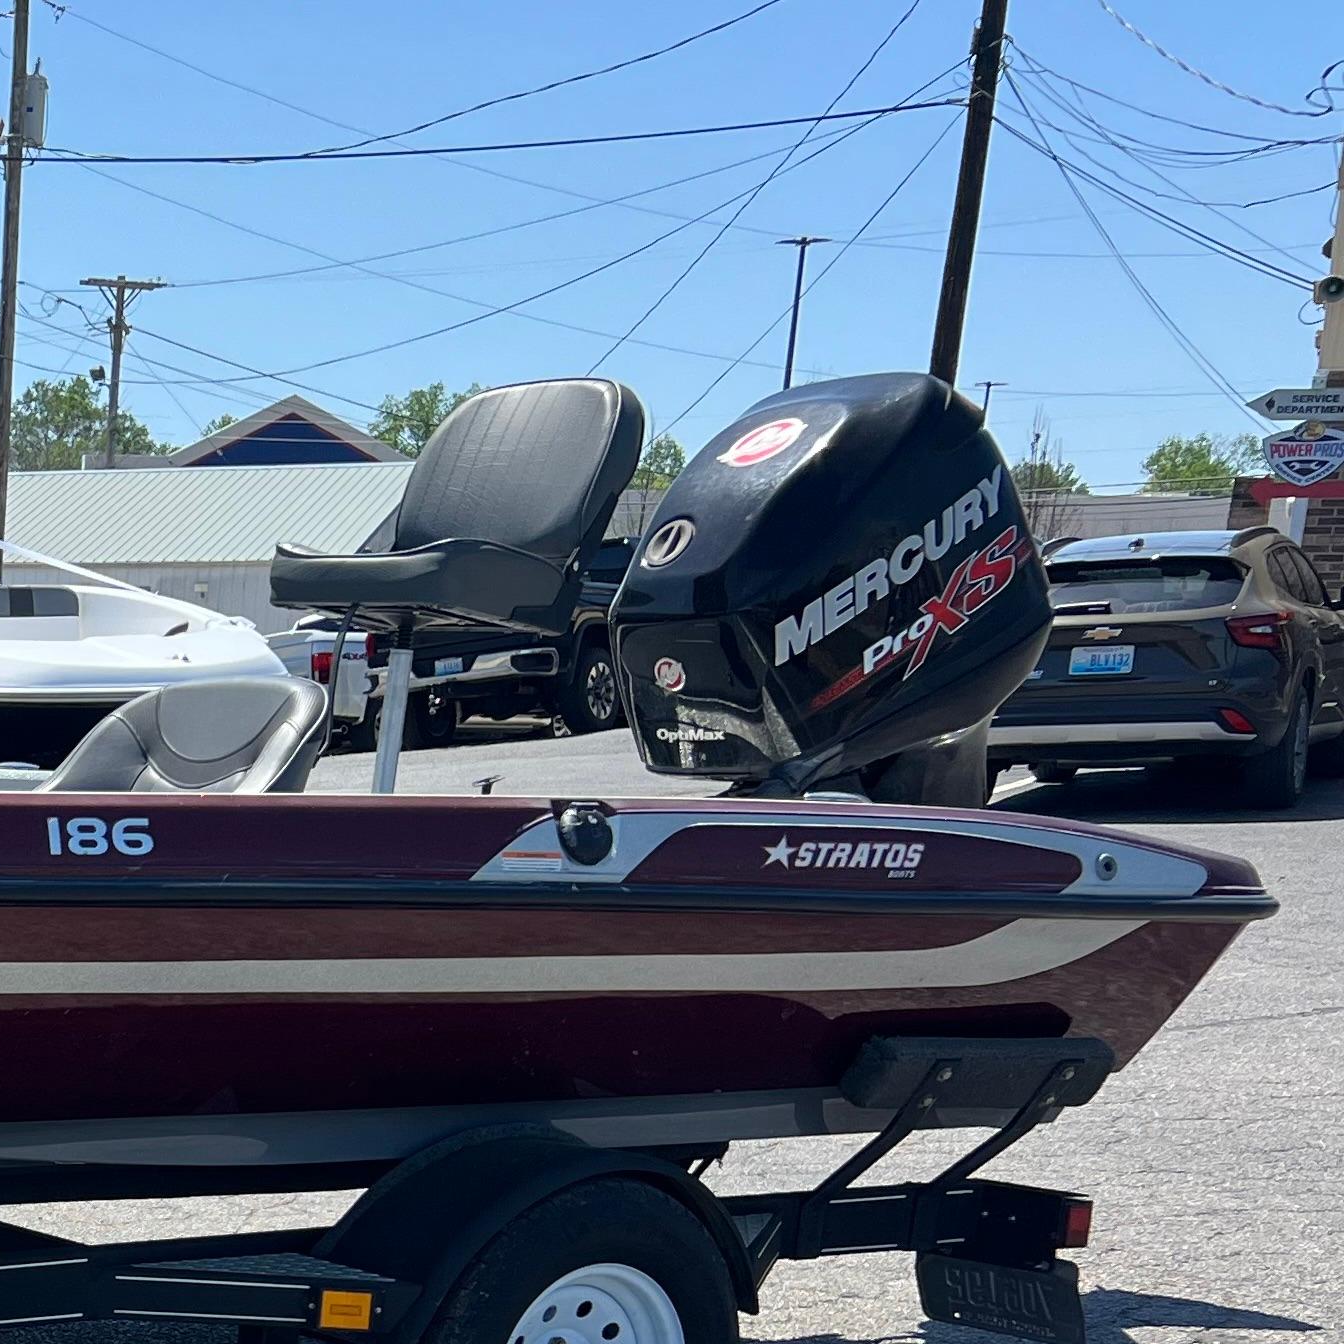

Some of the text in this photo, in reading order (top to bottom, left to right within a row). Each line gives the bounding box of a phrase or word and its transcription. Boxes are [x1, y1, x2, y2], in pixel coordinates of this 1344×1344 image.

[1292, 395, 1340, 403] SERVICE
[774, 463, 1001, 667] MERCURY
[656, 728, 726, 743] OptiMax
[47, 817, 154, 855] 186
[794, 842, 924, 868] STRATOS
